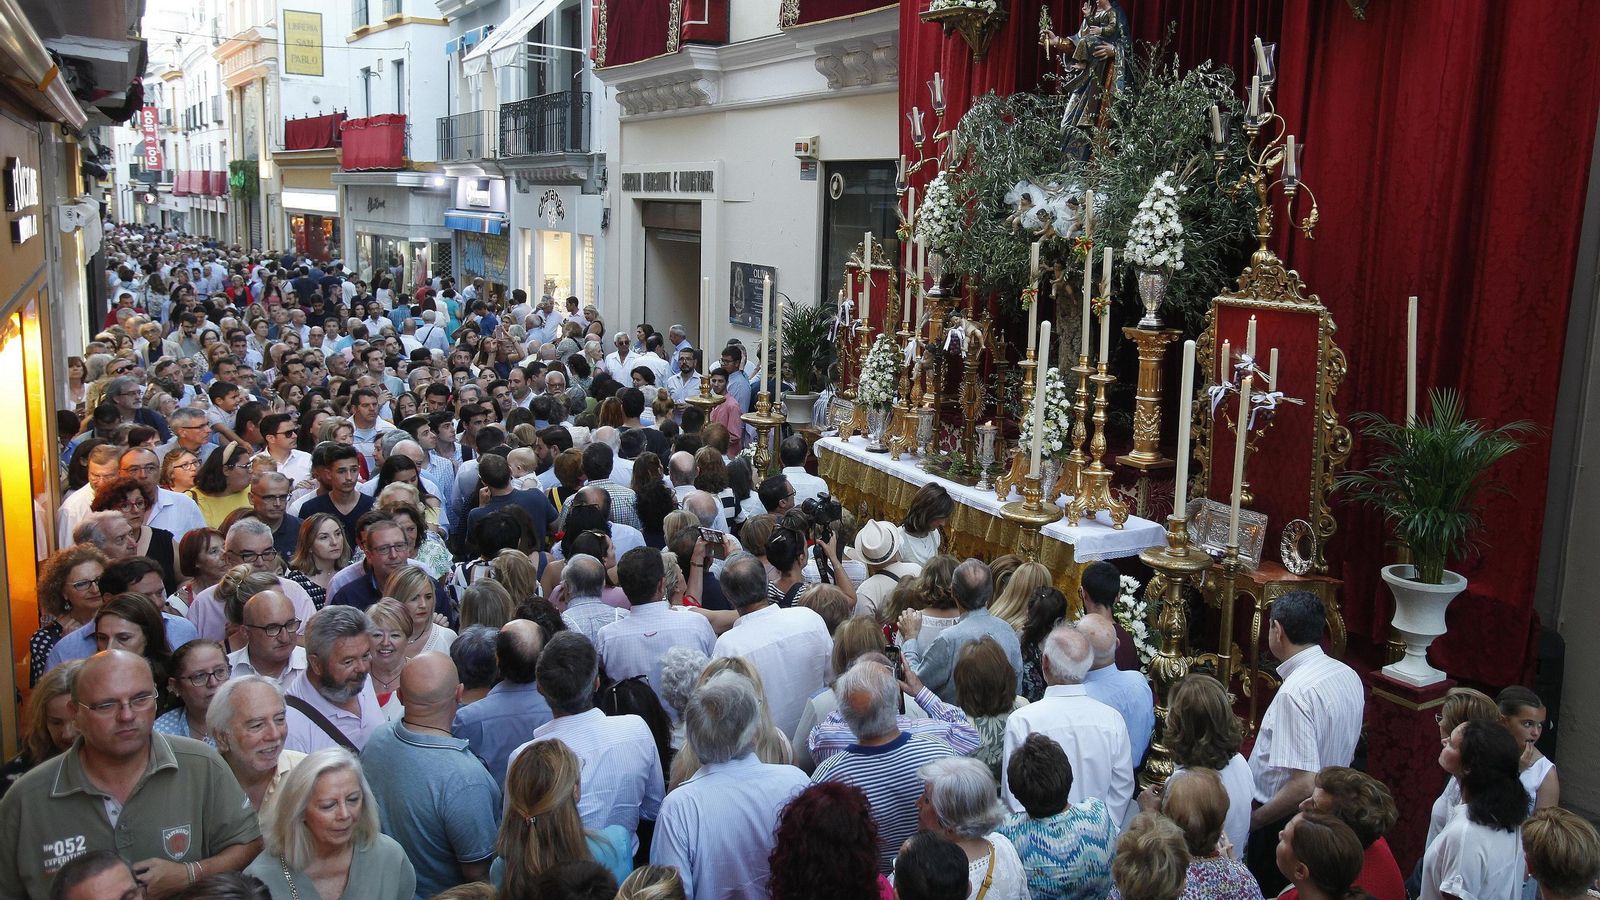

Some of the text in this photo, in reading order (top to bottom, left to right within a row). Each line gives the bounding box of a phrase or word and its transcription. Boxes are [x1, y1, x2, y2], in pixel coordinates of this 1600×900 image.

[296, 38, 314, 48] SAN
[291, 53, 318, 65] PABLO
[143, 110, 155, 133] stop
[145, 146, 158, 166] foot
[54, 835, 86, 857] 052
